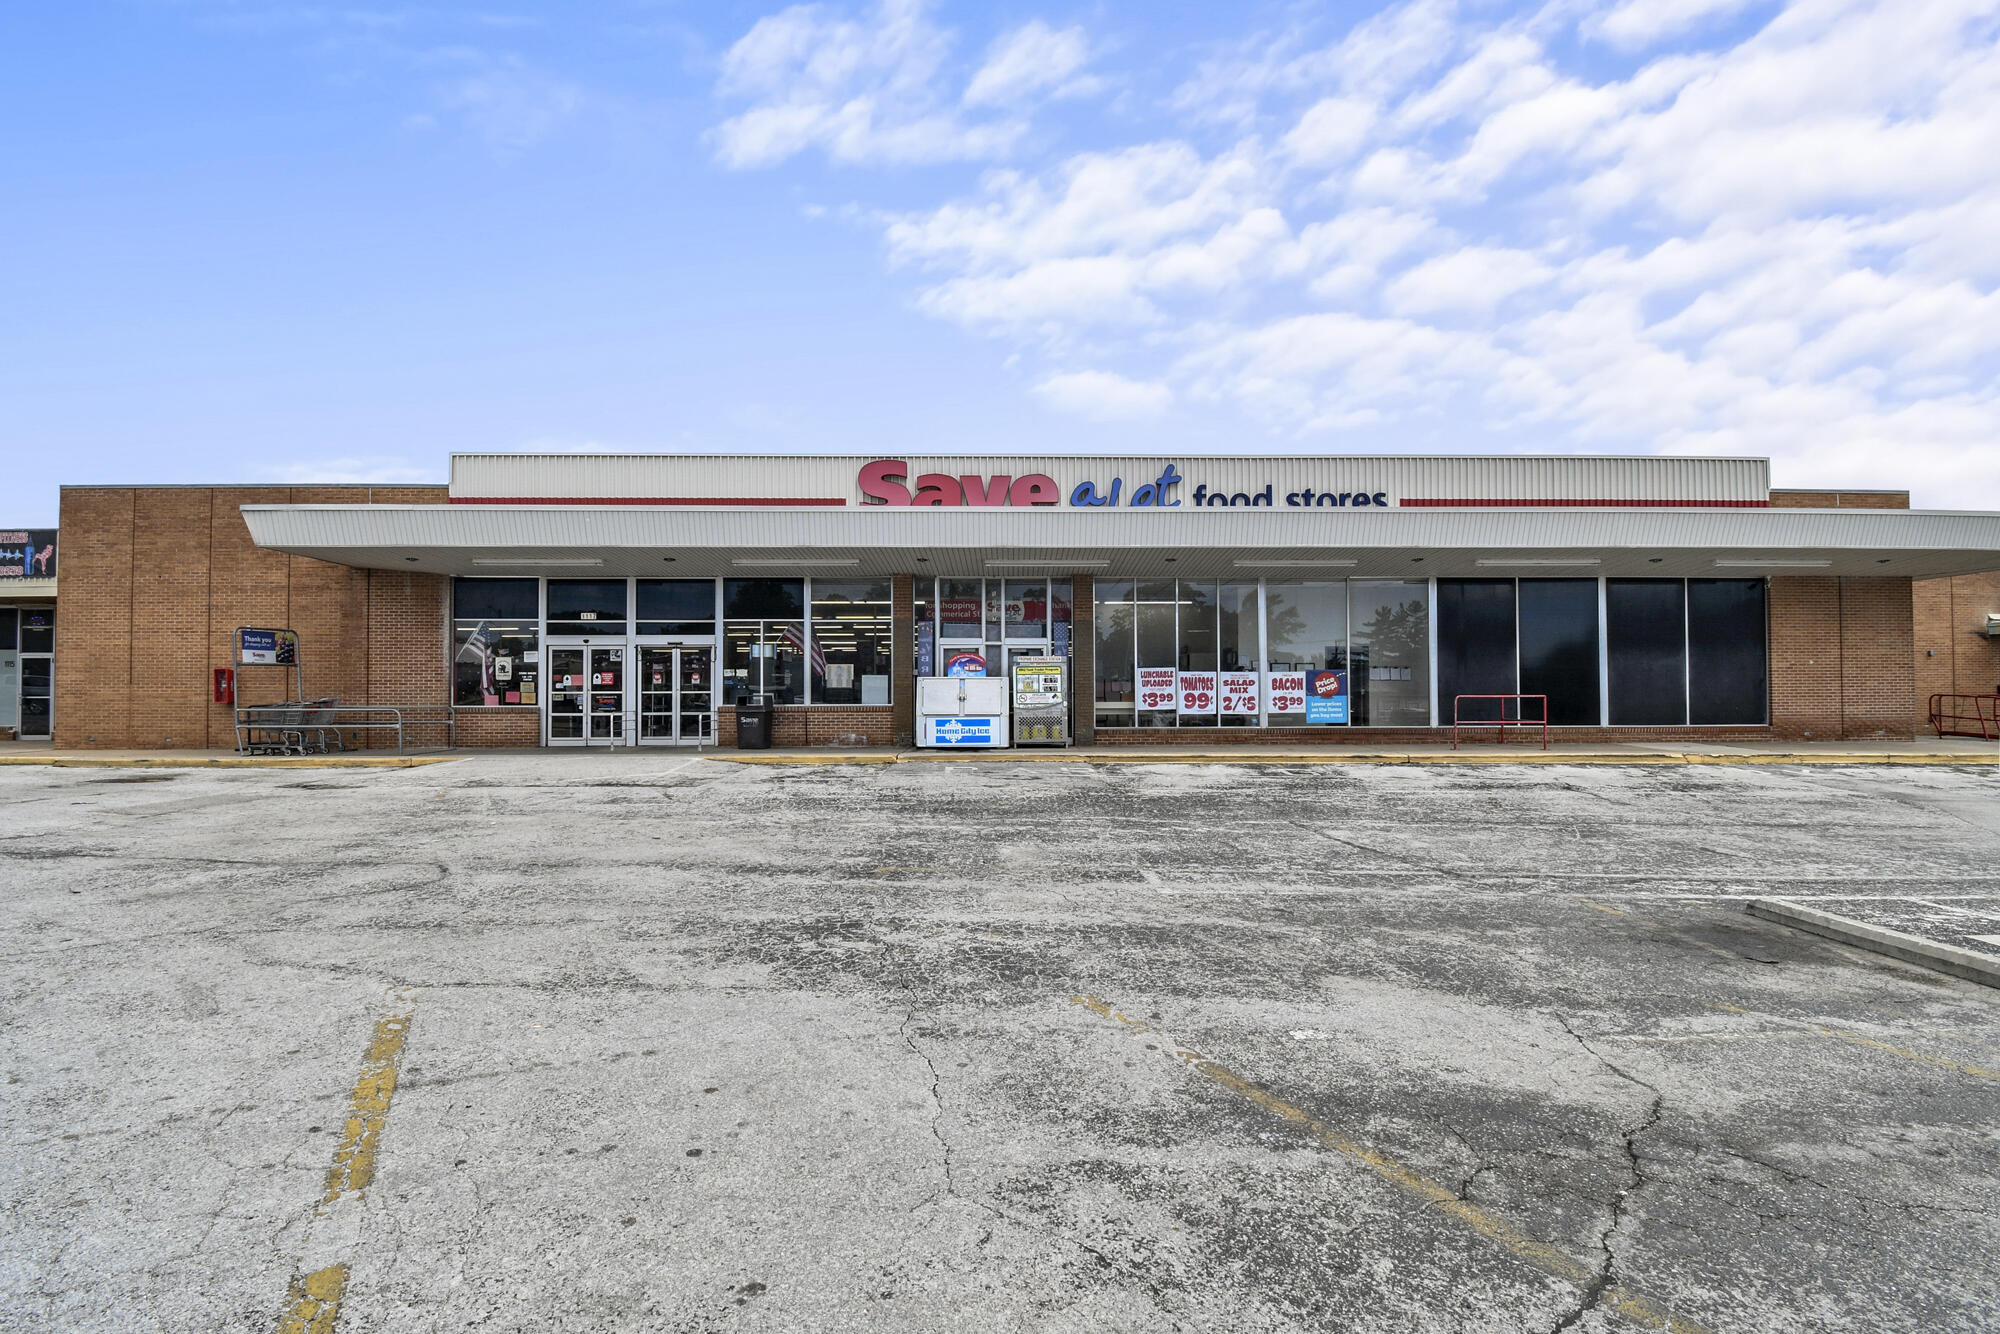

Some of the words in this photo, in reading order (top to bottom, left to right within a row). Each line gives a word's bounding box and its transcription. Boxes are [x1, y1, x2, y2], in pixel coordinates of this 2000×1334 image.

[858, 460, 1059, 506] Save
[942, 602, 976, 610] hopping
[1140, 670, 1174, 679] LUNCHABLE
[1141, 679, 1173, 688] UPLOADED
[1180, 676, 1214, 691] TOMATOES
[1222, 679, 1256, 687] SALAD
[1271, 677, 1304, 691] BACON
[1315, 677, 1335, 688] Price
[1317, 681, 1338, 694] Drop!
[1222, 695, 1256, 712] 2/$5
